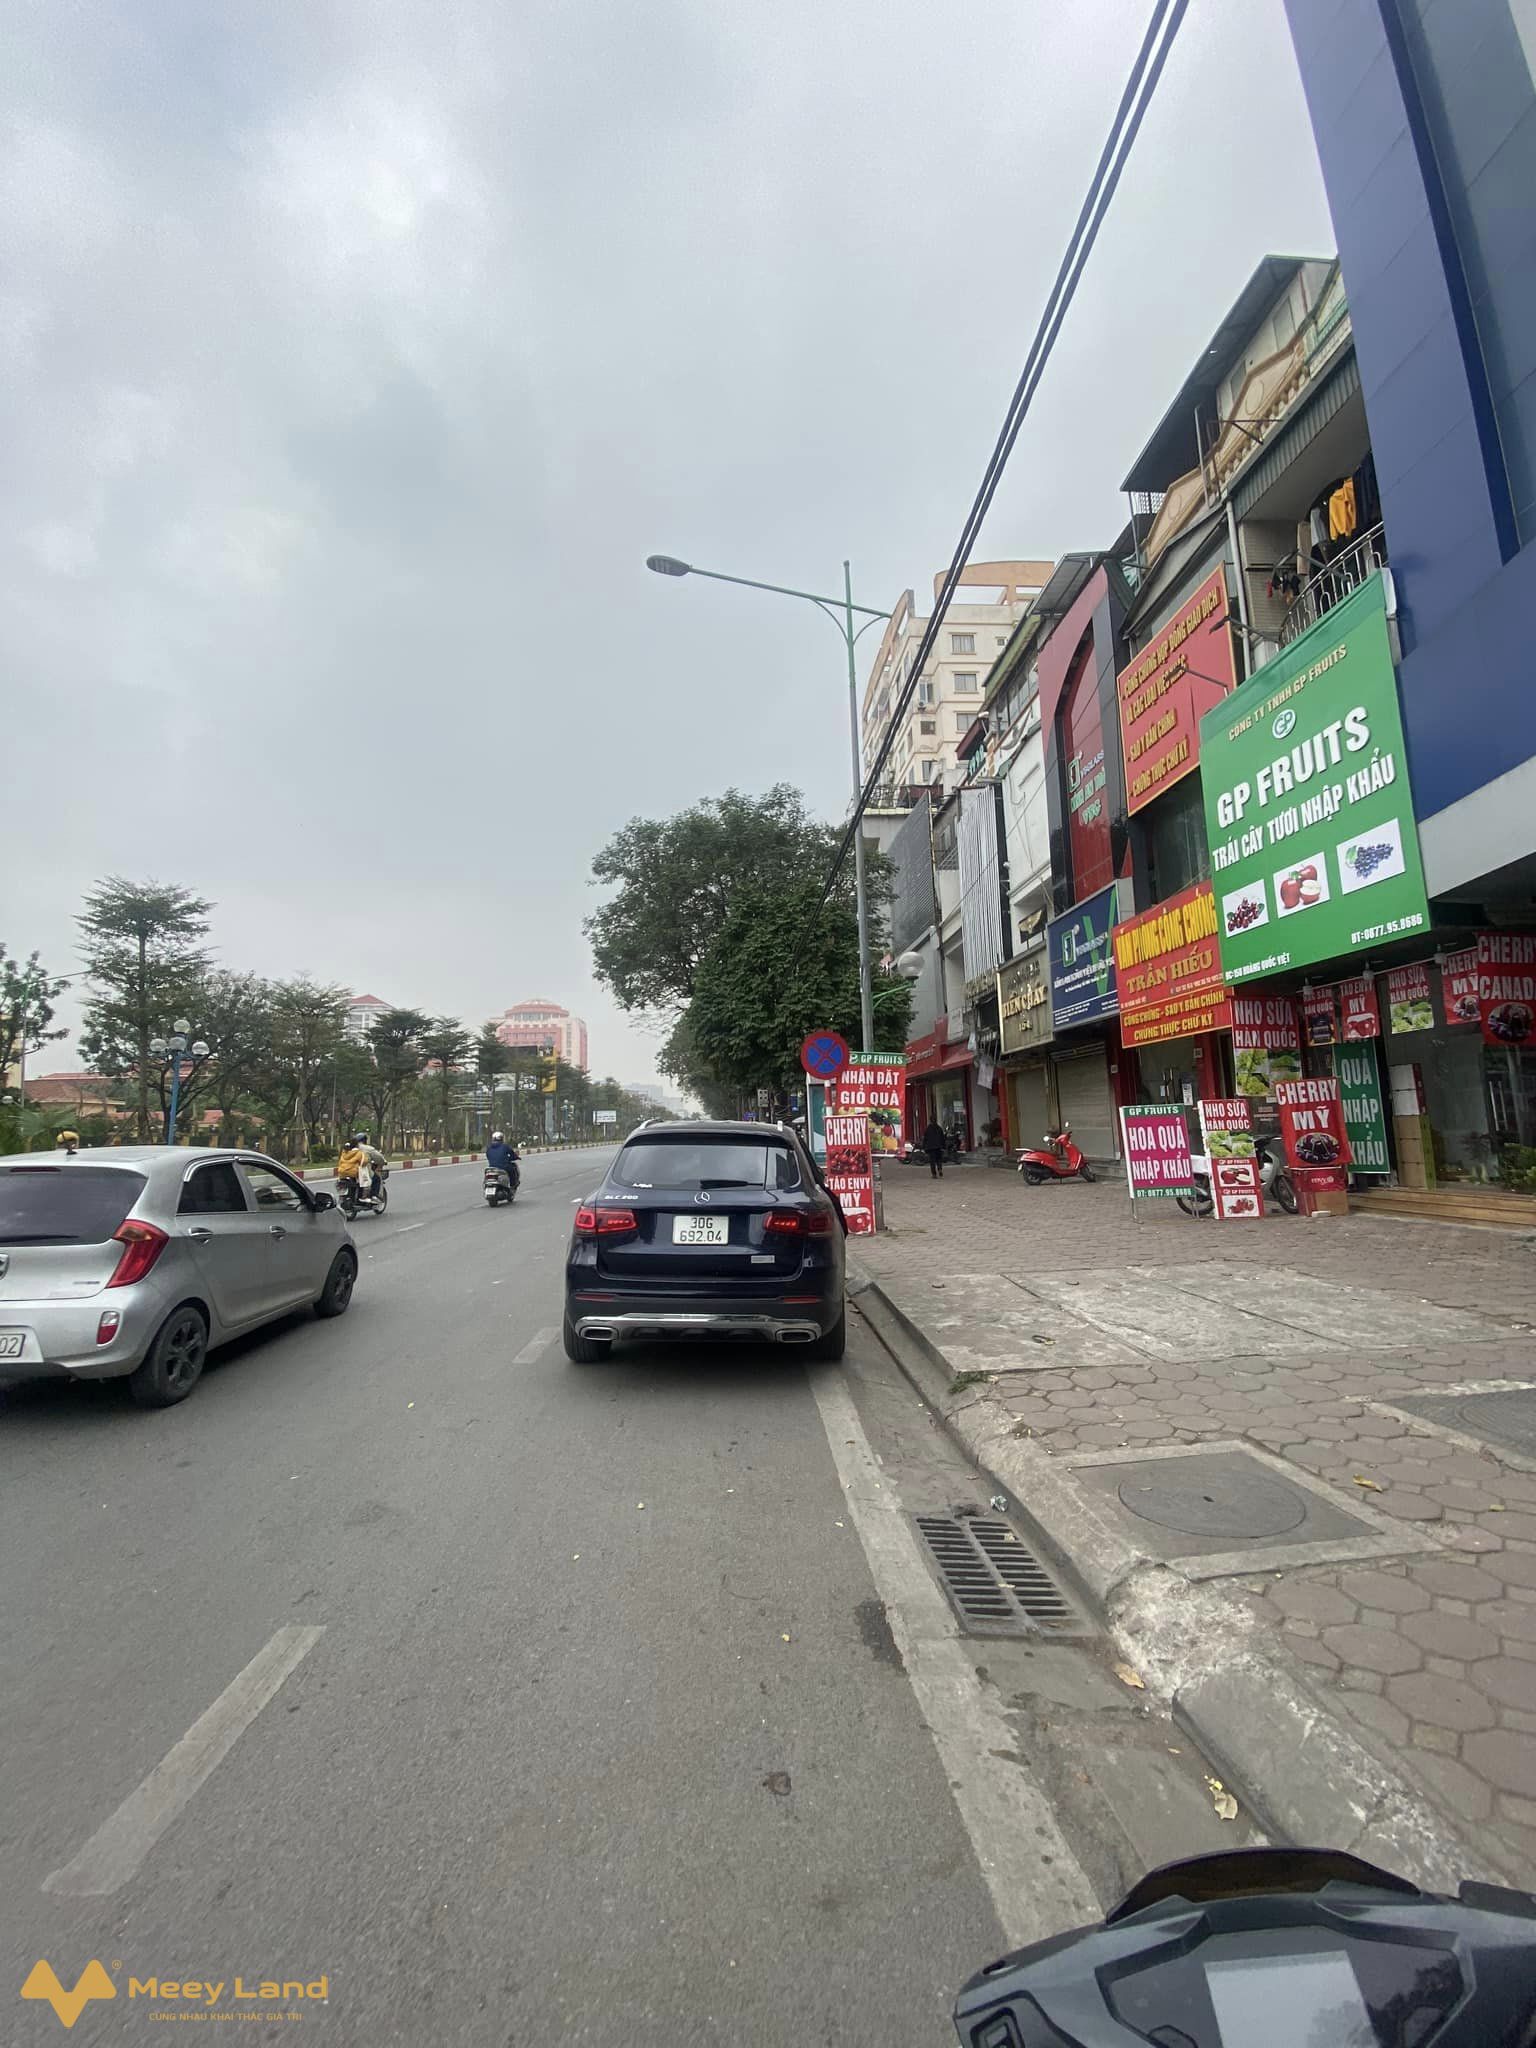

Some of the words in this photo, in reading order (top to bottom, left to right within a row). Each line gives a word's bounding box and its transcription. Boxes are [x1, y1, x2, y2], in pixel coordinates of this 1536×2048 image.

[1293, 674, 1308, 694] GP
[1309, 643, 1348, 682] FRUITS
[1216, 782, 1251, 828] GP
[1256, 706, 1370, 807] FRUITS
[1212, 837, 1239, 872] TRÁI
[1241, 825, 1265, 858] CÂY
[1267, 807, 1299, 845] TƯƠI
[1300, 785, 1343, 828] NHẬP
[1346, 748, 1396, 804] KHẨU
[1478, 936, 1536, 963] CHERR
[1127, 962, 1168, 994] TRẦN
[1171, 945, 1214, 980] HIẾU
[1441, 951, 1478, 976] CHERR
[1479, 975, 1536, 1001] CANAD
[1165, 1003, 1179, 1017] SAO
[1201, 989, 1225, 1007] CHÍNH
[1234, 1001, 1262, 1025] NHO
[1266, 996, 1294, 1026] SỮA
[1349, 993, 1366, 1014] MỸ
[1160, 1019, 1181, 1036] THỰC
[1236, 1025, 1261, 1048] HÀN
[1264, 1025, 1297, 1049] QUỐC
[861, 1055, 872, 1063] GP
[874, 1055, 903, 1064] FRUITS
[842, 1068, 874, 1090] NHẬN
[1276, 1079, 1337, 1106] CHERRY
[1129, 1107, 1143, 1116] GP
[1144, 1106, 1179, 1115] FRUITS
[1205, 1102, 1225, 1118] NHO
[1227, 1099, 1248, 1118] SỮA
[1291, 1105, 1330, 1131] MỸ
[1343, 1093, 1379, 1128] NHẬP
[826, 1117, 867, 1146] CHERRY
[1128, 1126, 1156, 1151] HOA
[1158, 1117, 1186, 1152] QUẢ
[1206, 1118, 1225, 1132] HÀN
[1226, 1116, 1250, 1131] QUỐC
[1348, 1130, 1385, 1166] KHẨU
[1132, 1156, 1160, 1184] NHẬP
[1162, 1152, 1191, 1179] KHẨU
[848, 1176, 871, 1191] ENVY
[839, 1188, 862, 1209] MỸ
[690, 1217, 714, 1229] 30G
[679, 1230, 722, 1243] 692.04
